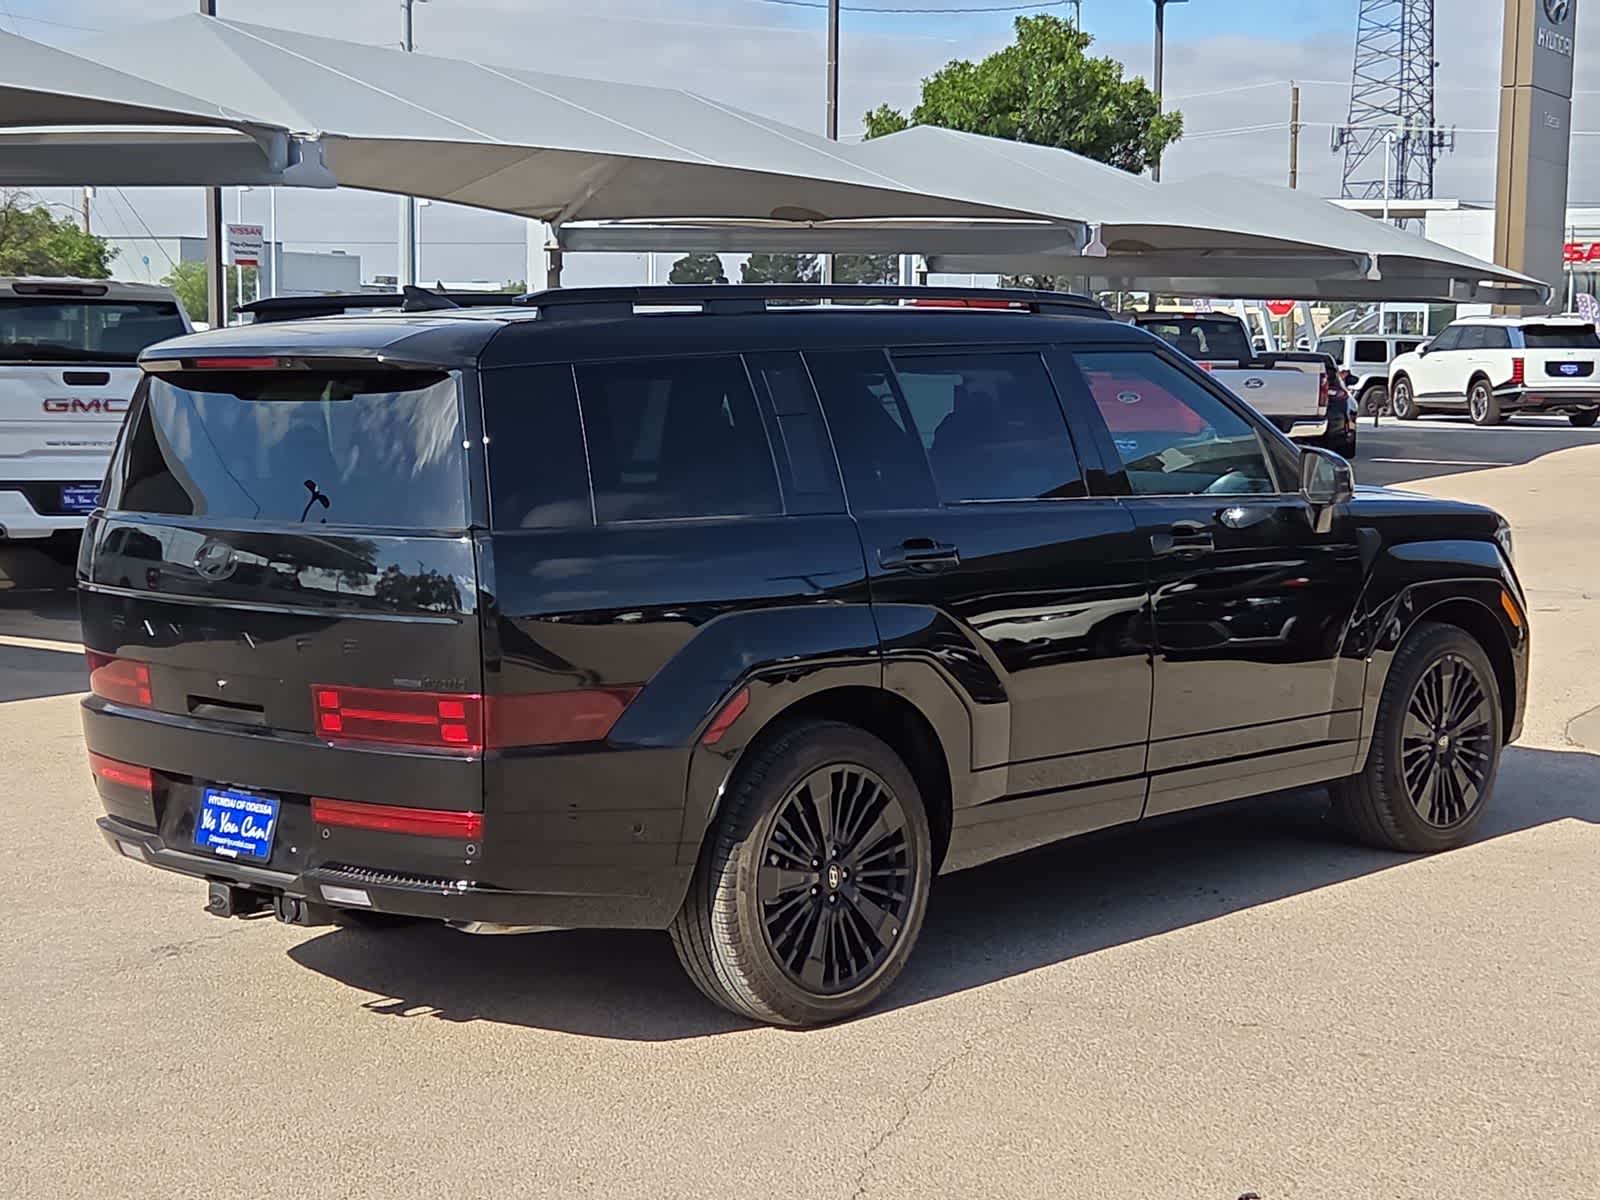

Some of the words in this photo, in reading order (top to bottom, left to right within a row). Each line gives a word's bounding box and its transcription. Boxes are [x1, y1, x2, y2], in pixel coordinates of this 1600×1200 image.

[43, 398, 129, 412] GMC
[236, 799, 246, 810] OF
[246, 802, 273, 816] ODESSA
[201, 808, 216, 831] Yes
[219, 811, 238, 833] You
[241, 815, 273, 842] Can!
